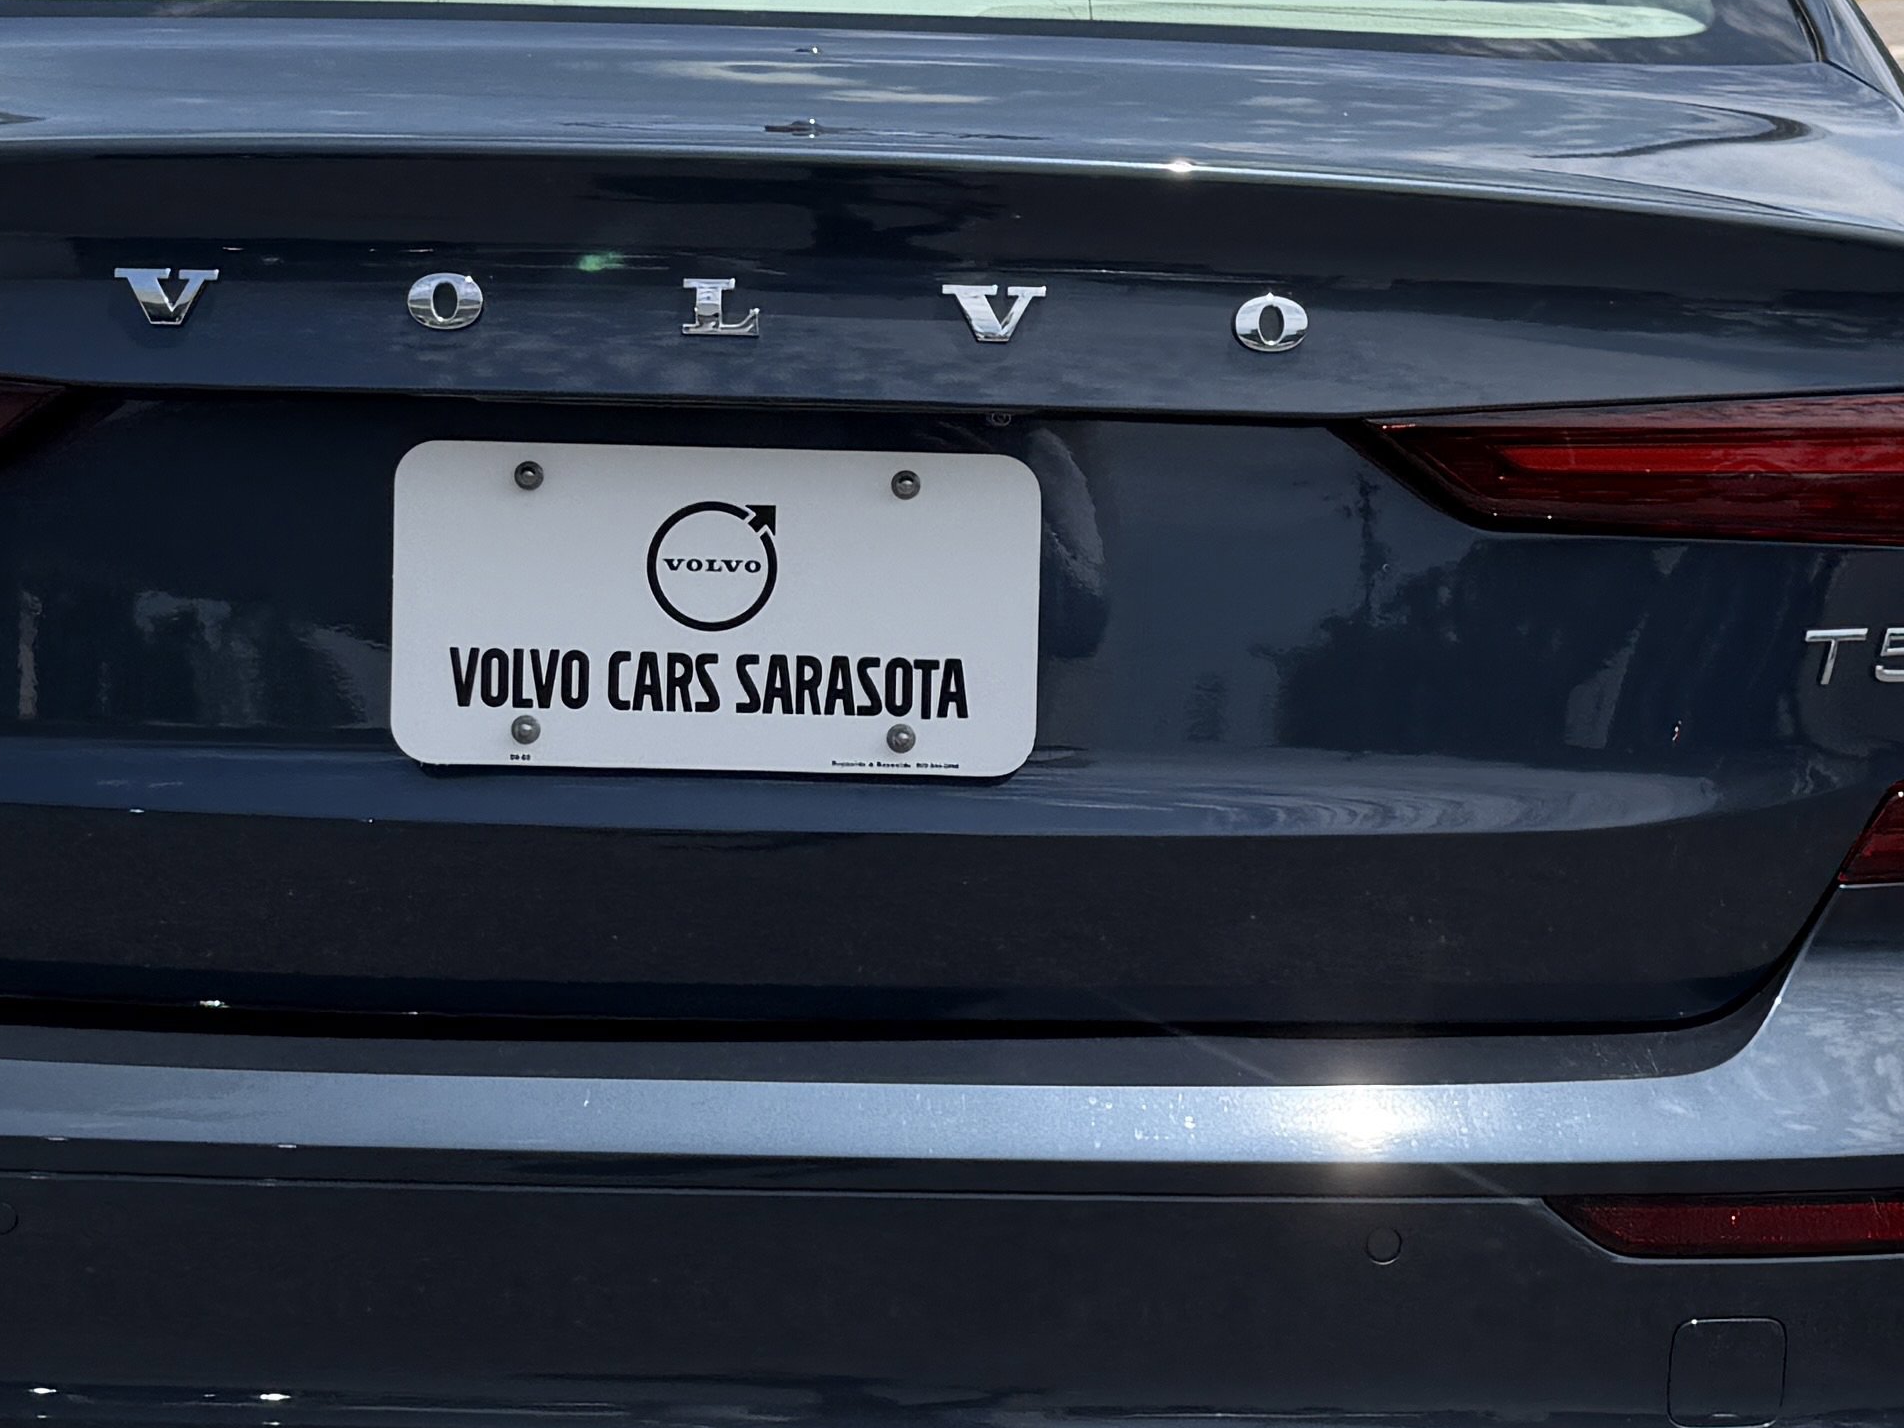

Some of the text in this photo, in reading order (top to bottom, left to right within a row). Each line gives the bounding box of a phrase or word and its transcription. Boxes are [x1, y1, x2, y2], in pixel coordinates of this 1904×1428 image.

[114, 266, 1310, 352] VOLVO
[662, 557, 761, 574] VOLVO
[449, 647, 968, 719] VOLVO CARS SARASOTA
